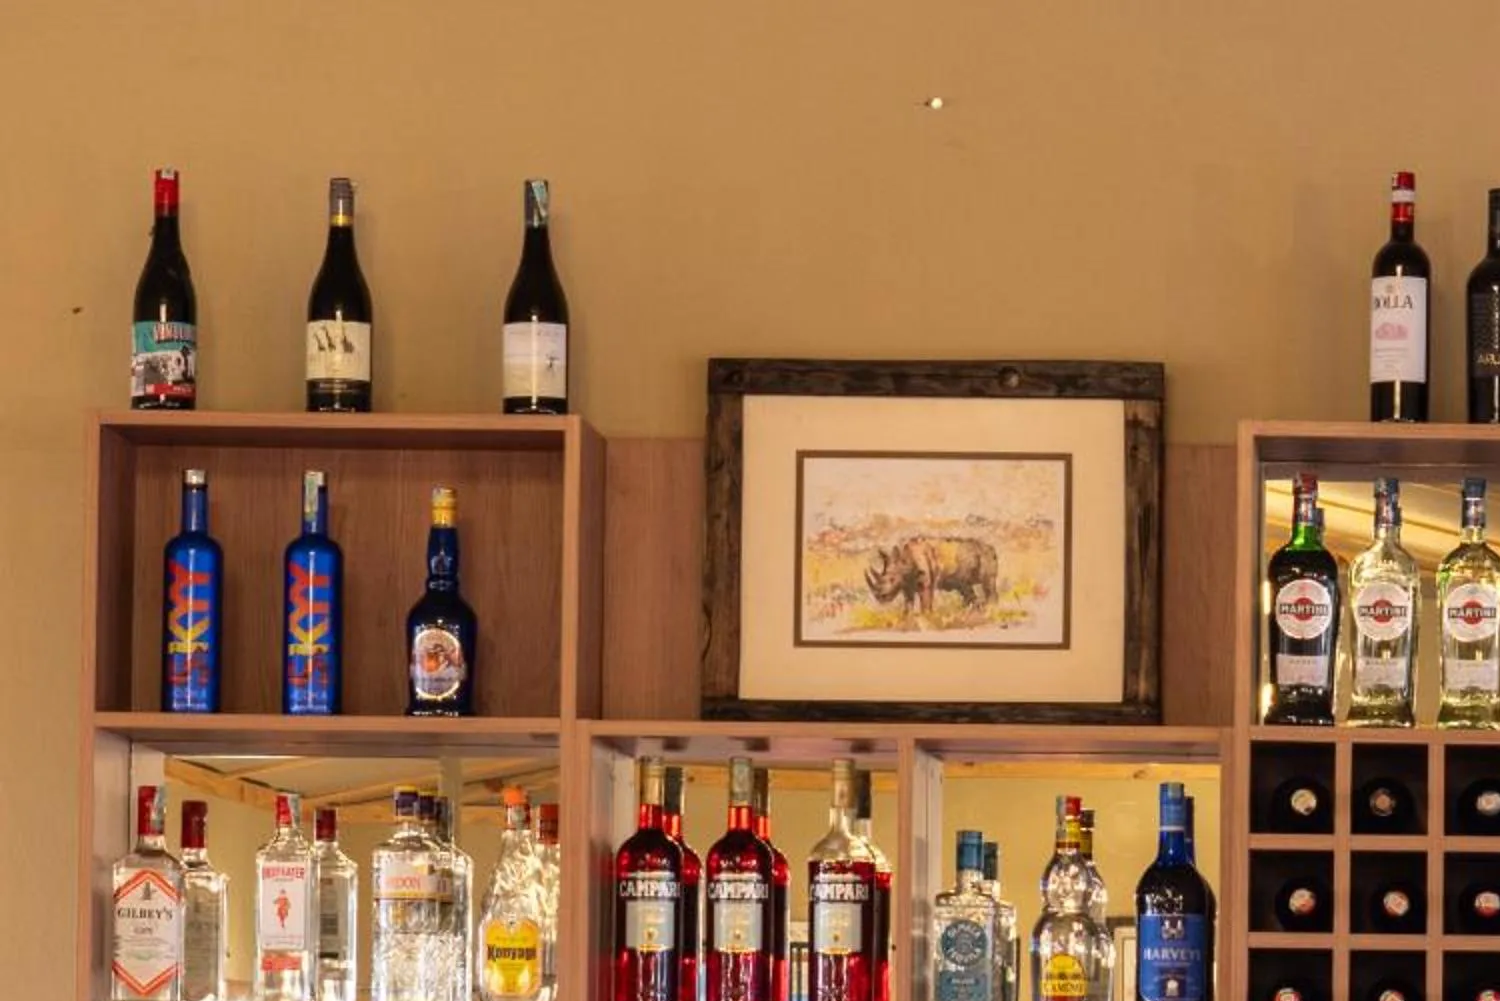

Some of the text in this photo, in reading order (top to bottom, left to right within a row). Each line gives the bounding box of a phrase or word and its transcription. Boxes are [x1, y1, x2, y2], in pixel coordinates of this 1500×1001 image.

[1279, 603, 1328, 616] MARTINI
[1358, 605, 1408, 618] MARTINI
[1447, 607, 1497, 619] MARTINI
[619, 881, 681, 898] CAMPARI
[707, 882, 769, 900] CAMPARI
[117, 905, 173, 920] GILBEY'S
